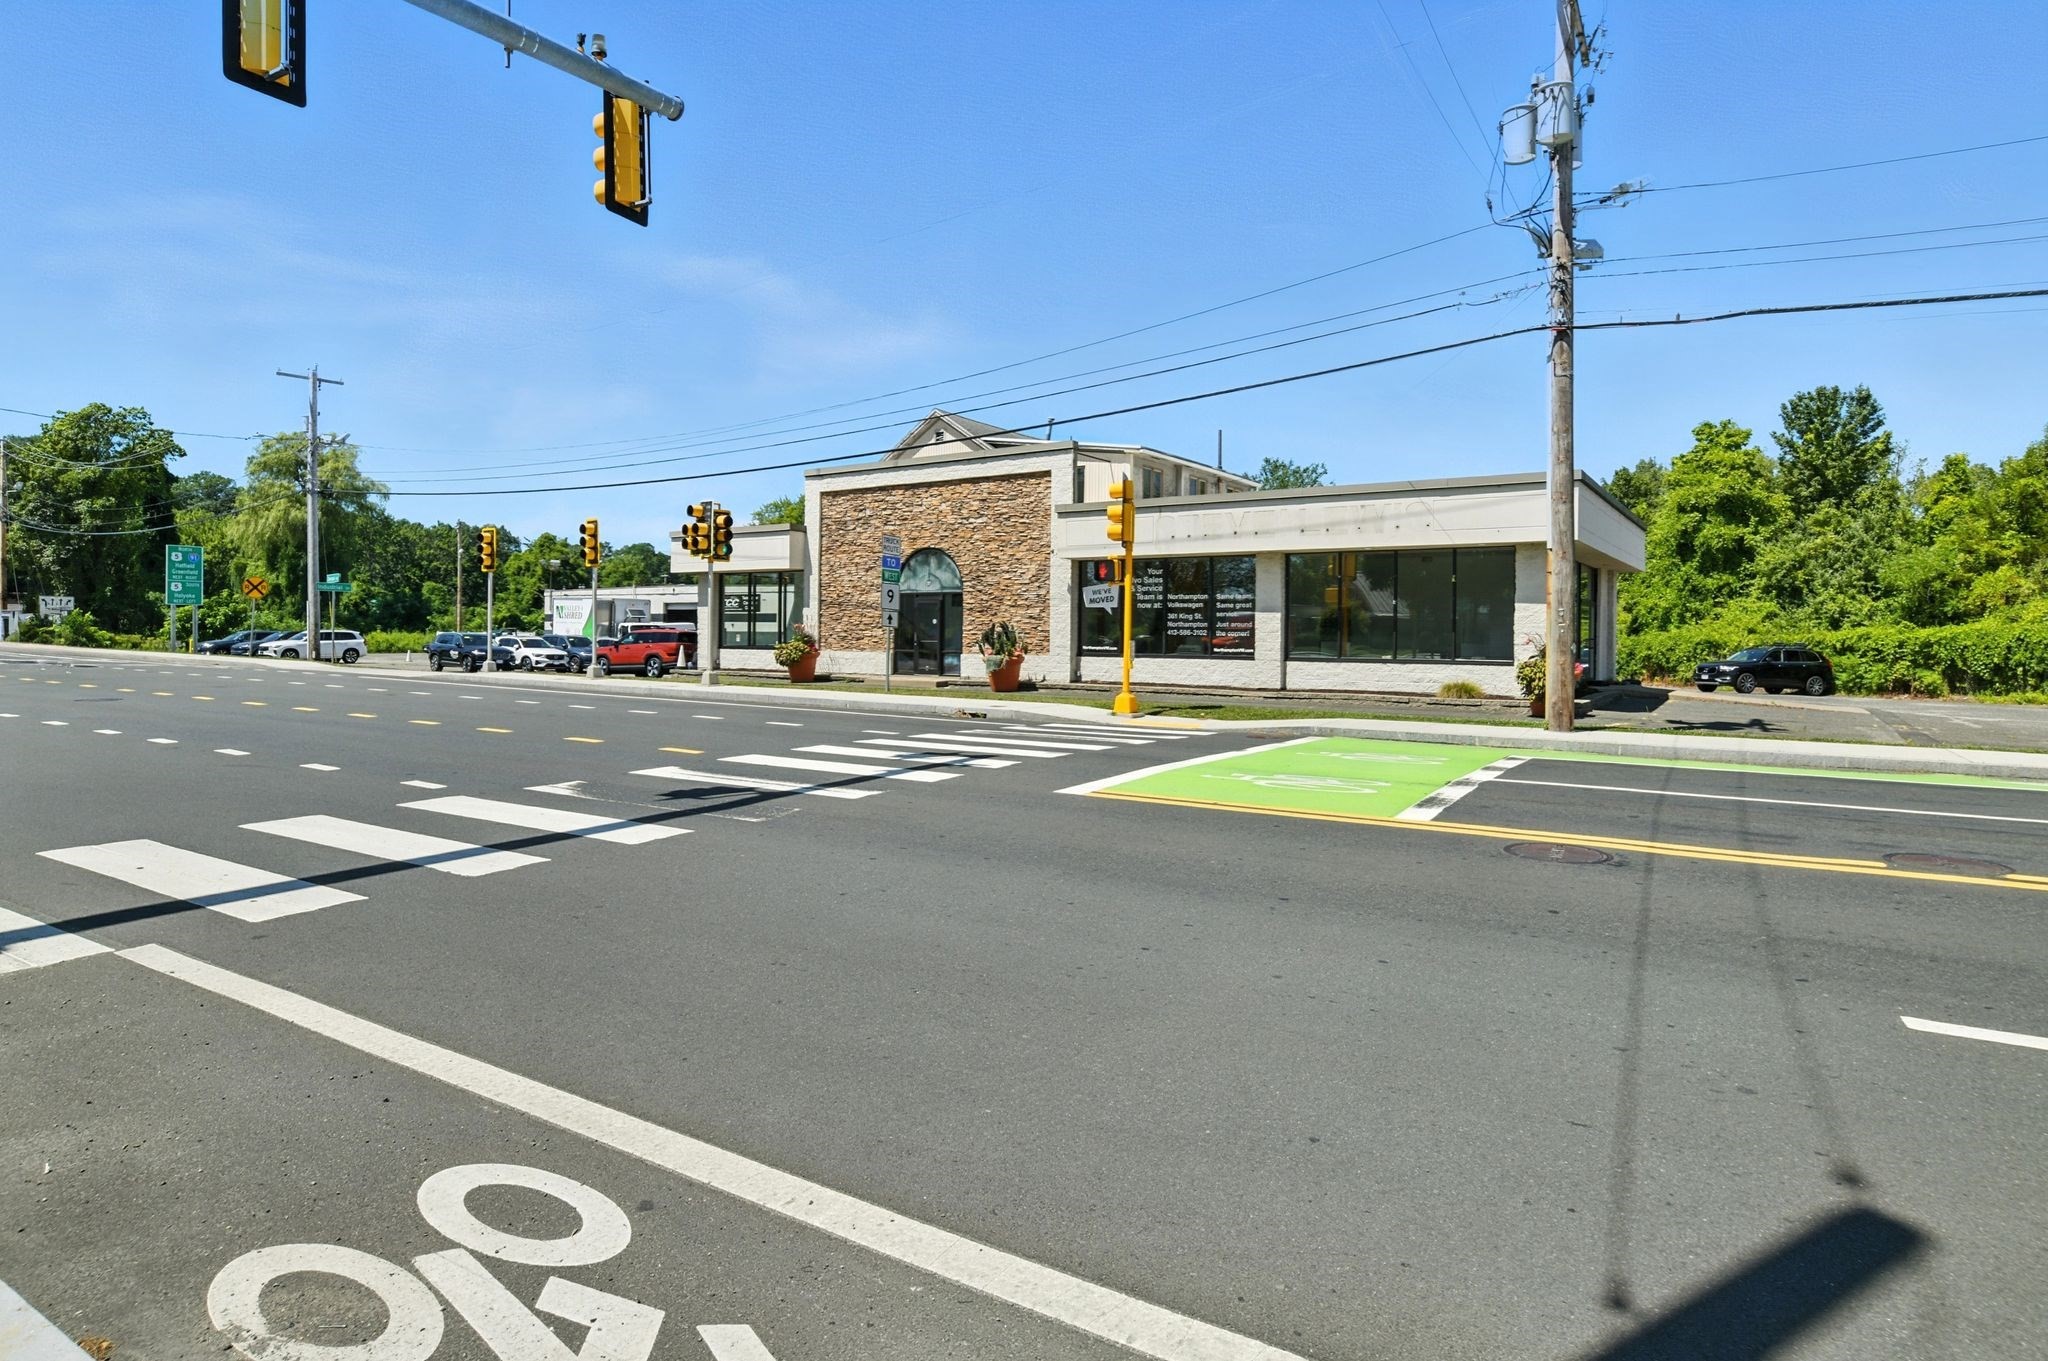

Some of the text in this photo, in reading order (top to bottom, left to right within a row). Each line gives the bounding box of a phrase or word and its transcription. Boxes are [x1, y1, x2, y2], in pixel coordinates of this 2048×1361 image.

[883, 545, 900, 553] ROUTE
[886, 558, 896, 566] TO
[884, 571, 899, 580] WEST
[887, 589, 894, 603] 9
[1089, 596, 1115, 604] MOVED
